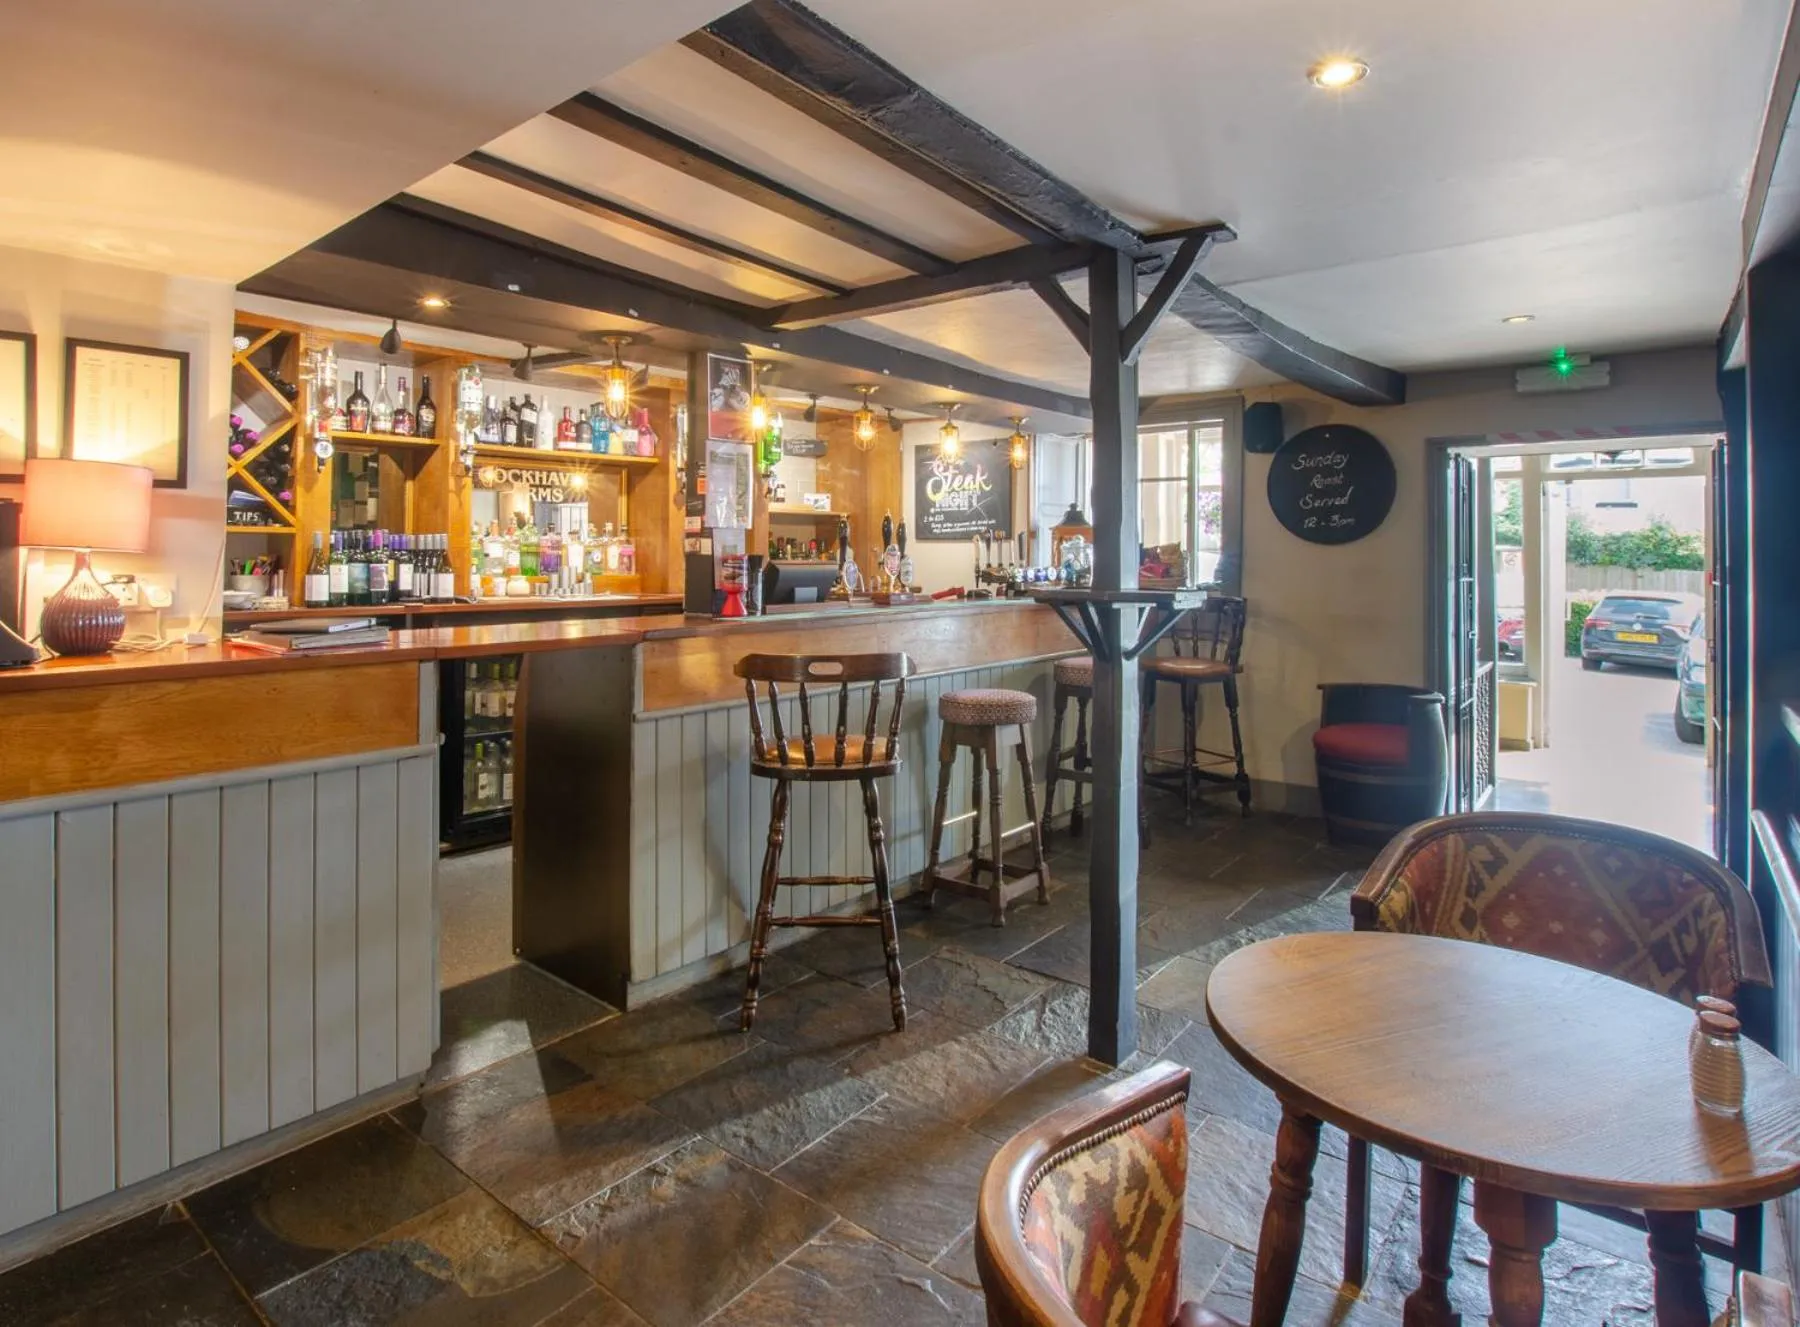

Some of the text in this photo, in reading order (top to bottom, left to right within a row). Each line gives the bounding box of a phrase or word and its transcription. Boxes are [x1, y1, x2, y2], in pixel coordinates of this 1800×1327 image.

[1291, 450, 1350, 470] Sunday
[478, 466, 588, 486] COCKHAV
[926, 463, 992, 501] Steak
[527, 488, 564, 503] RMS
[1299, 487, 1354, 510] Served
[233, 511, 260, 522] TIPS
